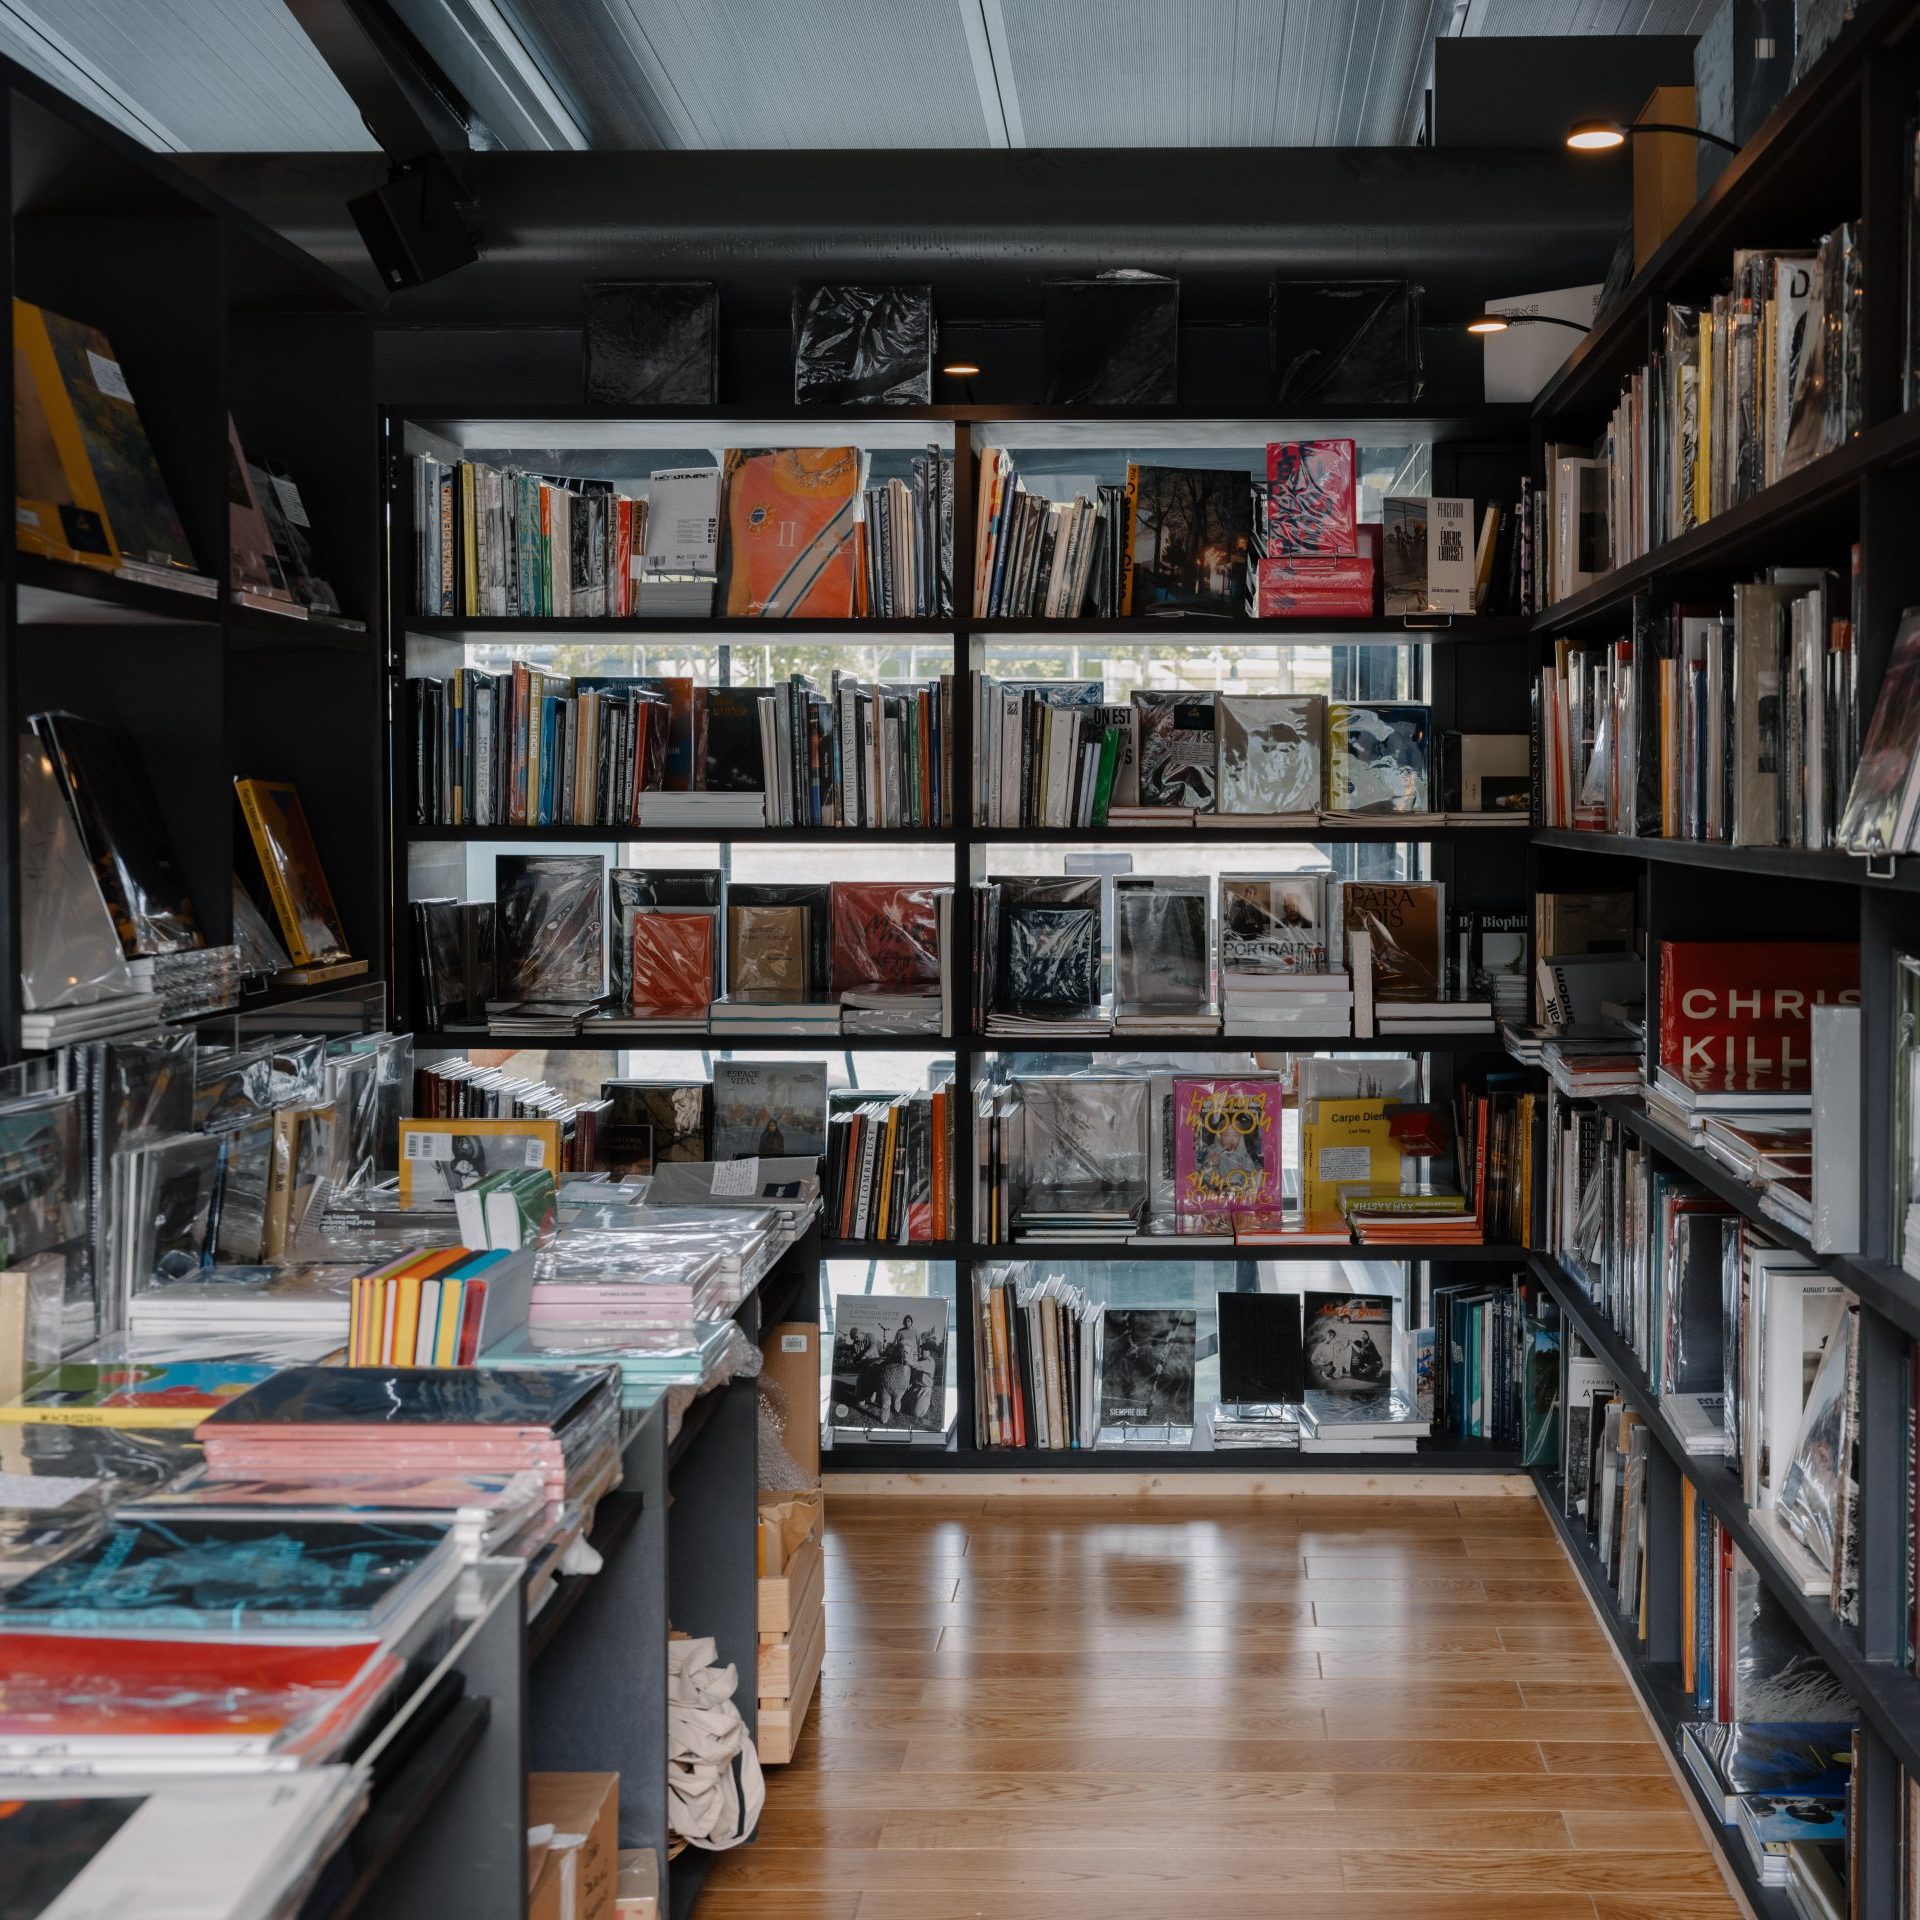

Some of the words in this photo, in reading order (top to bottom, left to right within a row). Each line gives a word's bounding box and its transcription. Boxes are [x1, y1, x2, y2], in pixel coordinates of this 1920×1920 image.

[442, 486, 453, 540] DEMAND
[1437, 502, 1464, 519] PERCEVOIR
[442, 542, 453, 593] THOMAS
[1093, 708, 1110, 724] ON
[1112, 708, 1132, 724] EST
[1351, 888, 1416, 908] PARA
[1547, 997, 1561, 1025] alk
[1681, 1035, 1809, 1070] KILL
[726, 1070, 760, 1078] ESPACE
[730, 1077, 756, 1085] VITAL
[1331, 1112, 1361, 1124] Carpe
[858, 1127, 877, 1222] VALLOMBREUSE
[1802, 1286, 1826, 1294] AUGUST
[1827, 1286, 1844, 1294] SAND
[1493, 1298, 1502, 1316] JR
[1503, 1301, 1512, 1318] JR
[1109, 1407, 1135, 1417] SIEMPRE
[1136, 1407, 1148, 1417] QUE
[1907, 1406, 1917, 1513] RICHARD
[1907, 1521, 1917, 1611] AVEDON
